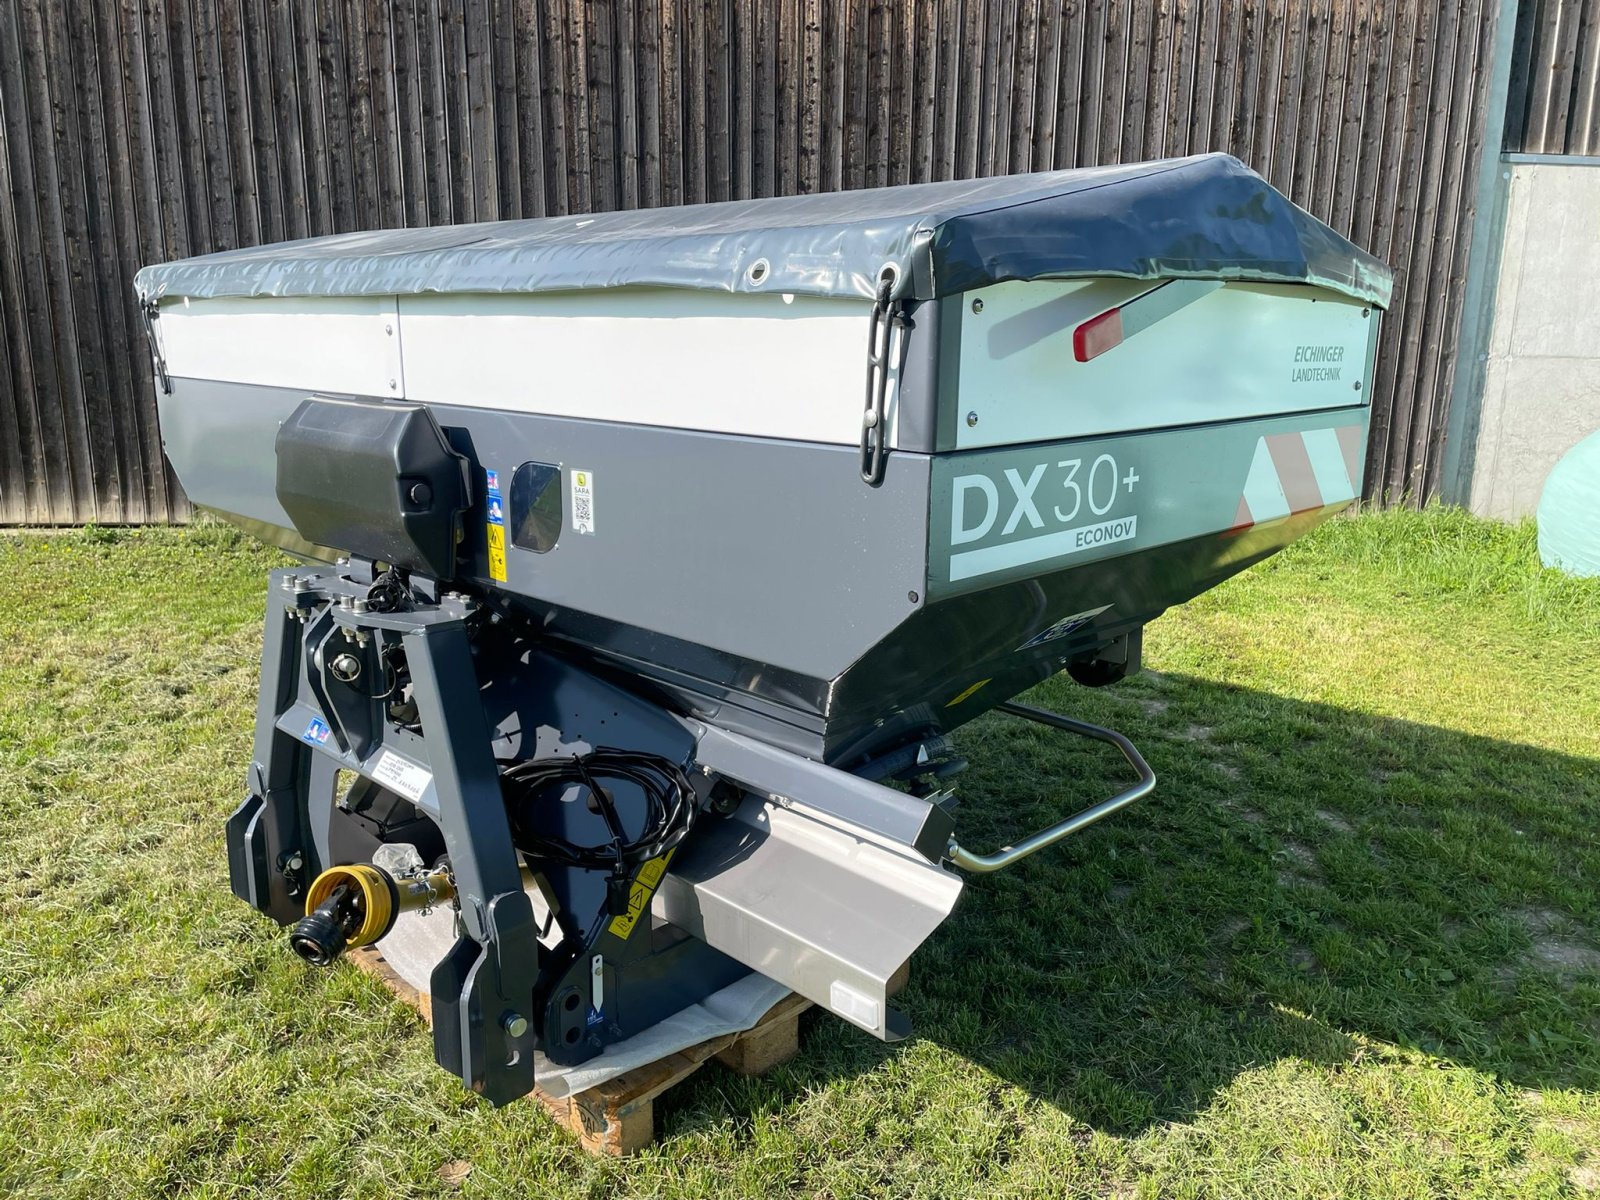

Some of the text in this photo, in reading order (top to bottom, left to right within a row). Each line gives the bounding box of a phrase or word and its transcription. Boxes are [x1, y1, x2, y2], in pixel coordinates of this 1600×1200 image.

[1294, 345, 1344, 363] EICHINGER
[1292, 367, 1341, 382] LANDTECHNIK
[1076, 521, 1133, 548] ECONOV
